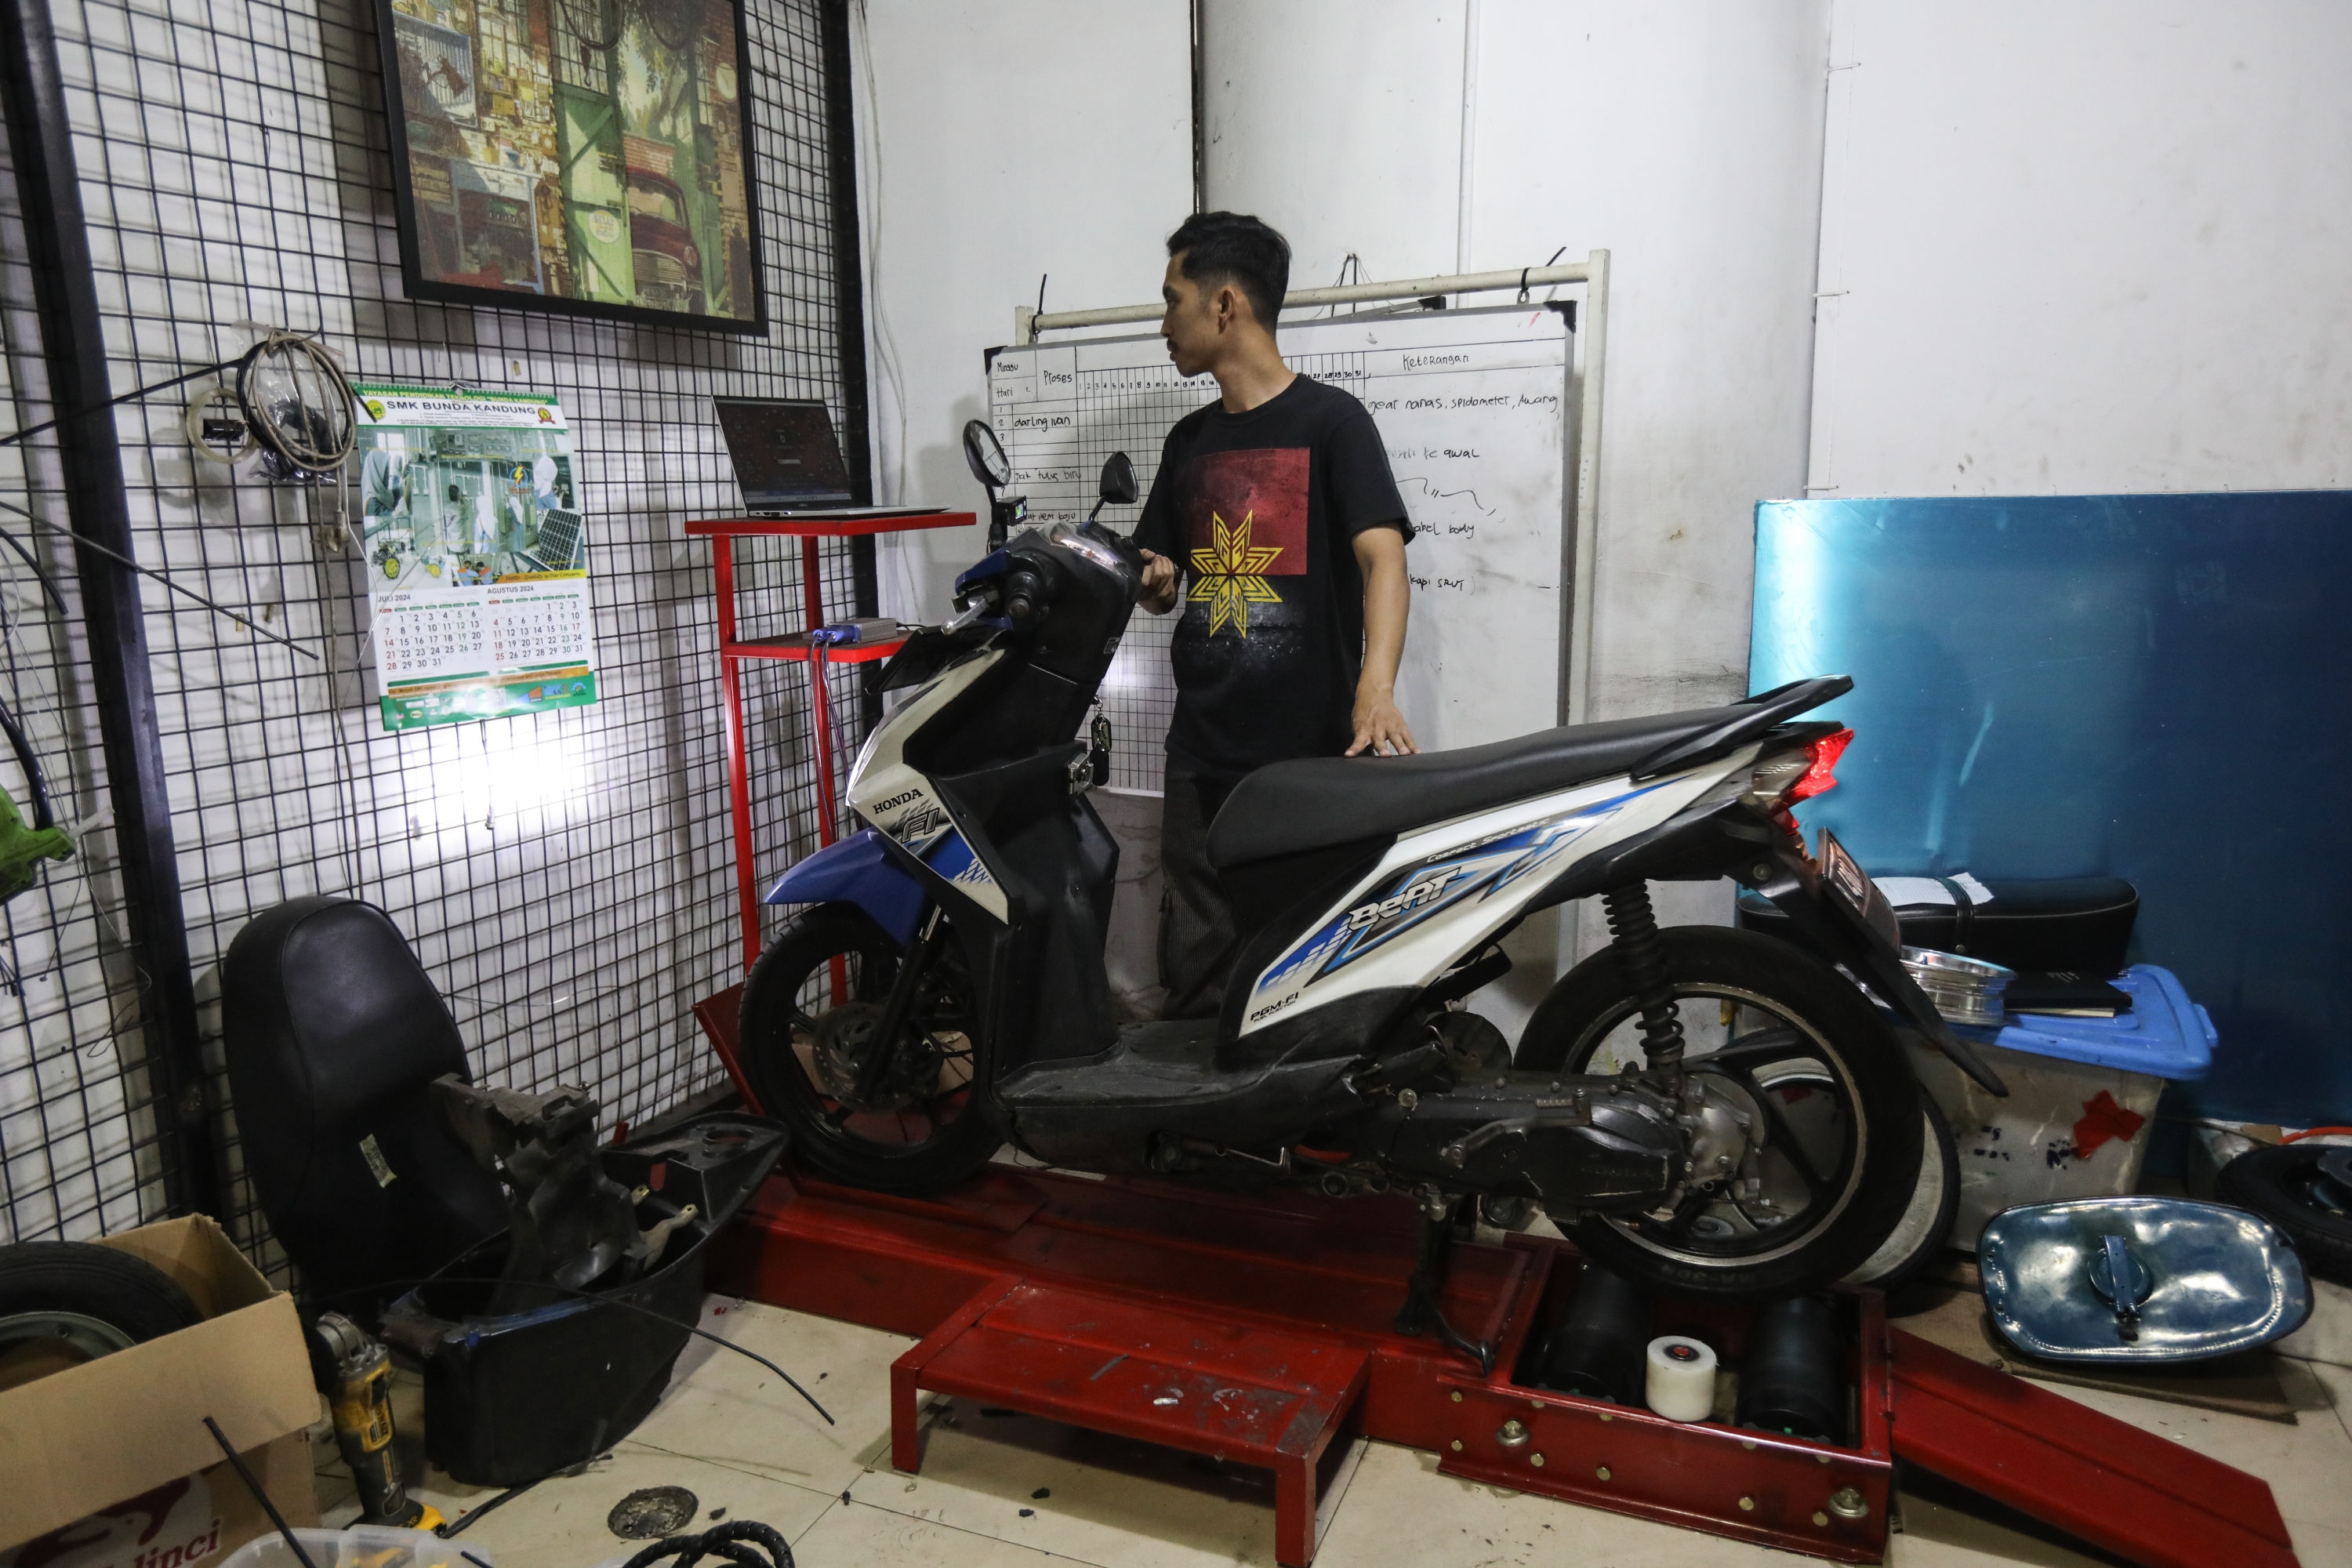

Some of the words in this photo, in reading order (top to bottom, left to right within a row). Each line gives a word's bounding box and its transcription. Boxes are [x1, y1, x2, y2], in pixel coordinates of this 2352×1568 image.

[1044, 370, 1073, 386] Proses
[996, 387, 1013, 397] Hari
[423, 402, 470, 411] BUNDA
[474, 405, 536, 415] KANDUNG
[1367, 399, 1399, 416] gear
[1443, 448, 1480, 459] awal
[1413, 521, 1441, 535] abel
[488, 586, 518, 594] AGUSTUS
[873, 789, 924, 814] HONDA
[902, 807, 940, 844] FI
[1427, 842, 1477, 862] Compact
[1269, 1000, 1296, 1015] INJECTION
